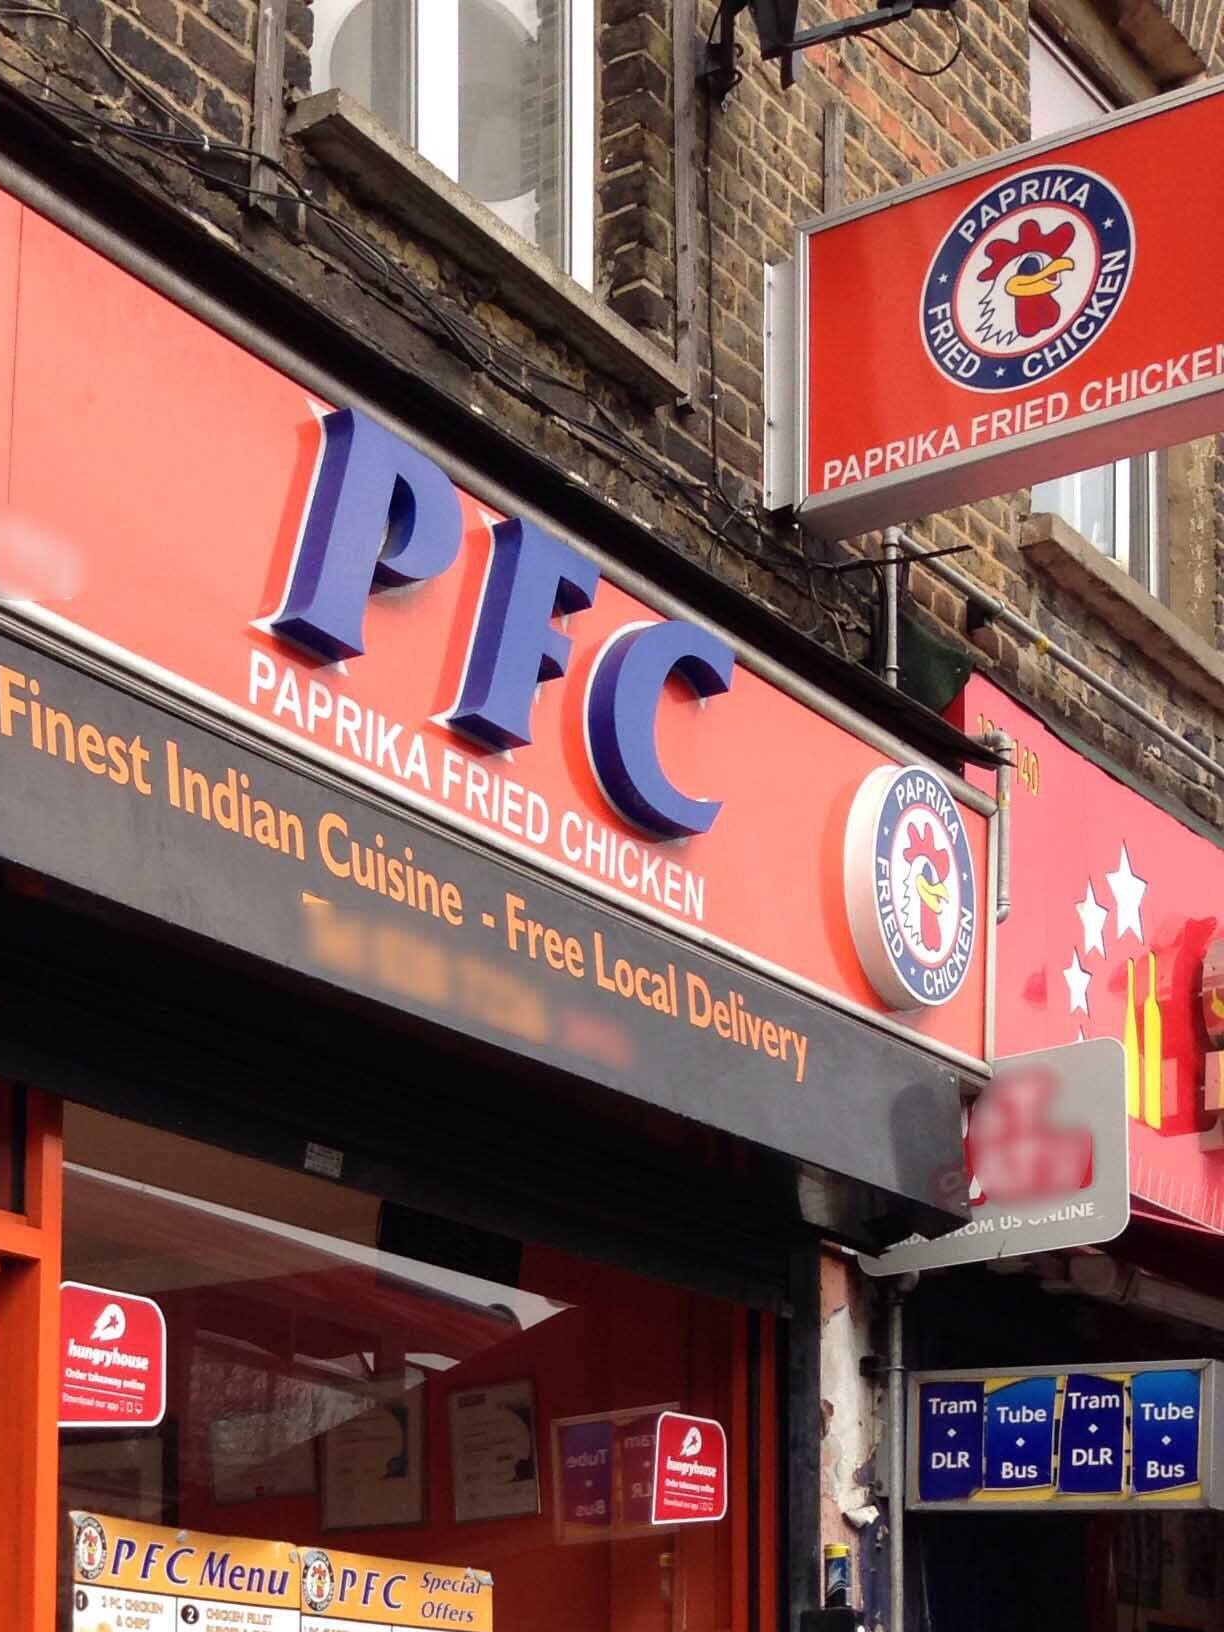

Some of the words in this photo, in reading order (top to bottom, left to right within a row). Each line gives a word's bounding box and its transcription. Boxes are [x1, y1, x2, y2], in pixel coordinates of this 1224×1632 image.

[958, 174, 1094, 245] PAPRIKA
[1021, 247, 1128, 379] CHICKEN
[927, 300, 982, 380] FRIED
[822, 421, 961, 490] PAPRIKA
[969, 391, 1069, 447] FRIED
[249, 398, 736, 843] PFC
[248, 648, 432, 790] PAPRIKA
[442, 745, 550, 844] FRIED
[560, 809, 706, 922] CHICKEN
[895, 776, 960, 845] PAPRIKA
[165, 738, 305, 862] Indian
[318, 812, 464, 926] Cuisine
[505, 892, 585, 979] Free
[595, 931, 678, 1018] Local
[687, 973, 810, 1084] Delivery
[877, 856, 905, 959] FRIED
[923, 907, 974, 996] CHICKEN
[944, 1218, 994, 1240] ROM
[68, 1339, 150, 1370] hungryhouse
[65, 1368, 87, 1380] Order
[928, 1398, 978, 1415] Tram
[1068, 1391, 1121, 1410] Tram
[1140, 1402, 1195, 1421] Tube
[996, 1406, 1047, 1424] Tube
[665, 1455, 718, 1478] hungryhouse
[931, 1451, 971, 1469] DLR
[1071, 1447, 1113, 1466] DLR
[1001, 1462, 1038, 1480] Bus
[1146, 1460, 1185, 1478] Bus
[111, 1538, 196, 1585] PFC
[200, 1550, 289, 1596] Menu
[338, 1567, 407, 1610] PFC
[420, 1571, 481, 1595] Special
[125, 1598, 164, 1615] CHICKEN
[206, 1607, 244, 1624] CHICKEN
[421, 1600, 474, 1624] Offers
[125, 1616, 150, 1631] CHIPS
